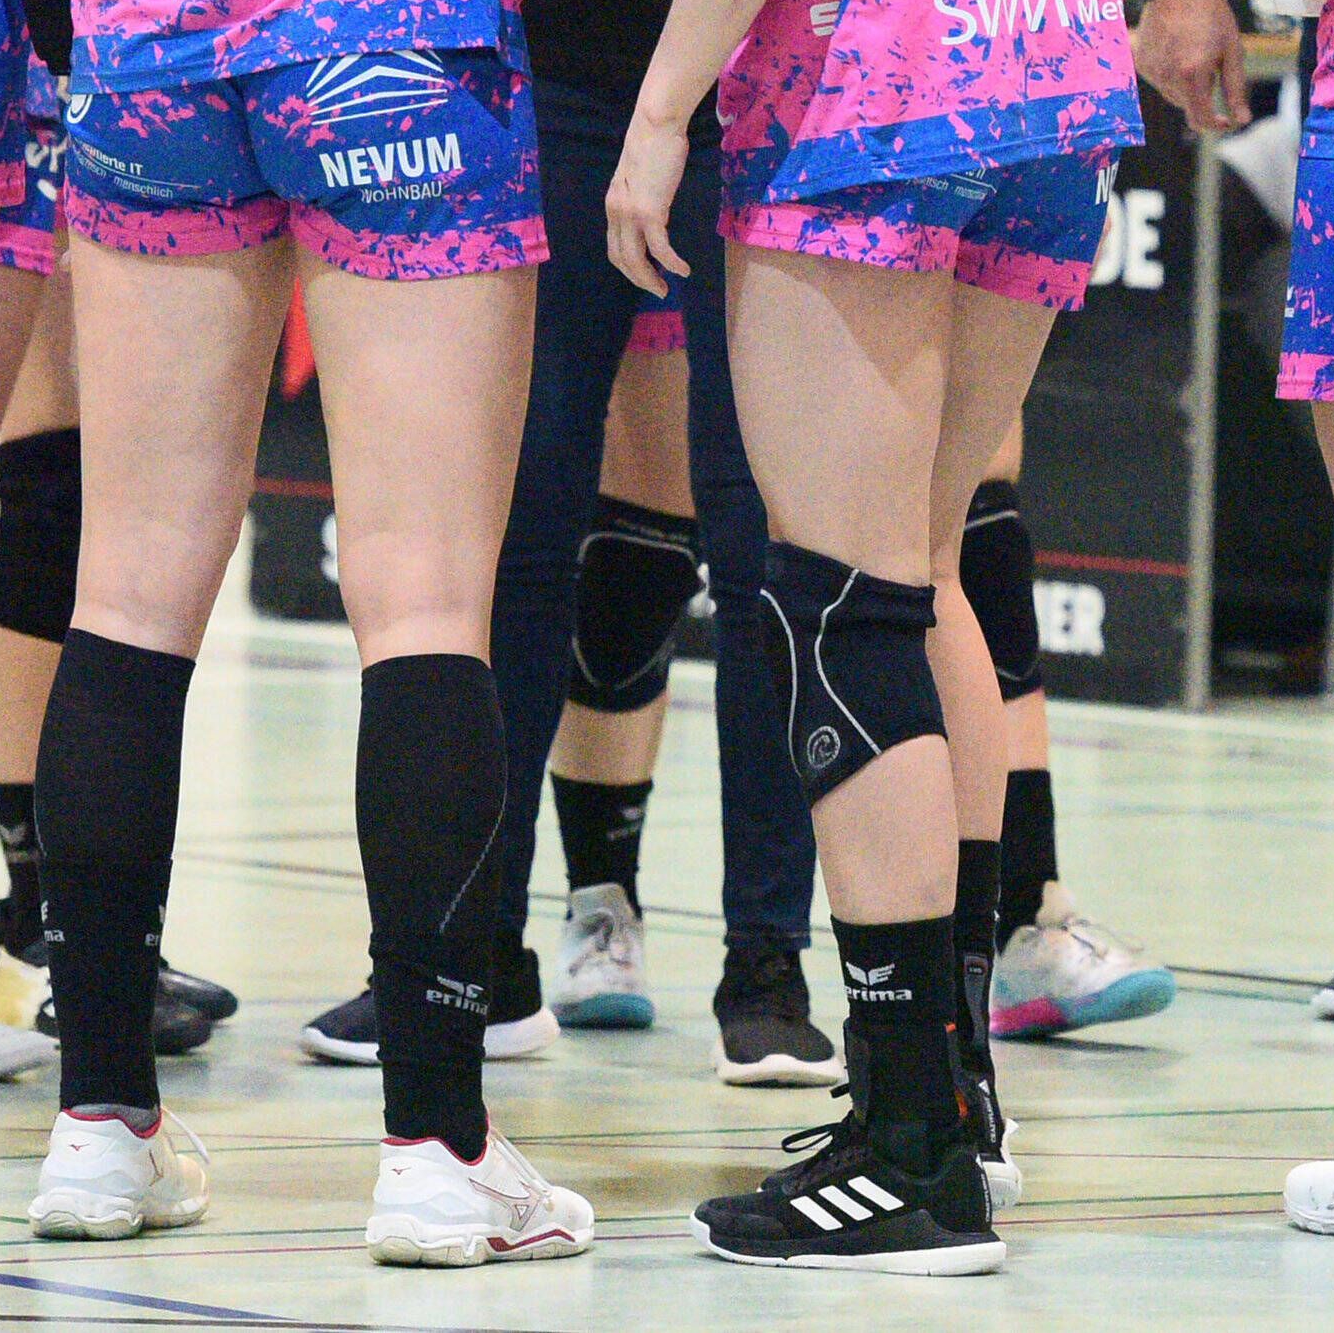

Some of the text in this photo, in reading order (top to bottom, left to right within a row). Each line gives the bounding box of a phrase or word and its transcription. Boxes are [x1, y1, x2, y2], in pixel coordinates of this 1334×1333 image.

[129, 161, 144, 176] IT
[319, 133, 463, 189] NEVUM
[113, 175, 174, 200] menschlich
[426, 988, 490, 1016] erima
